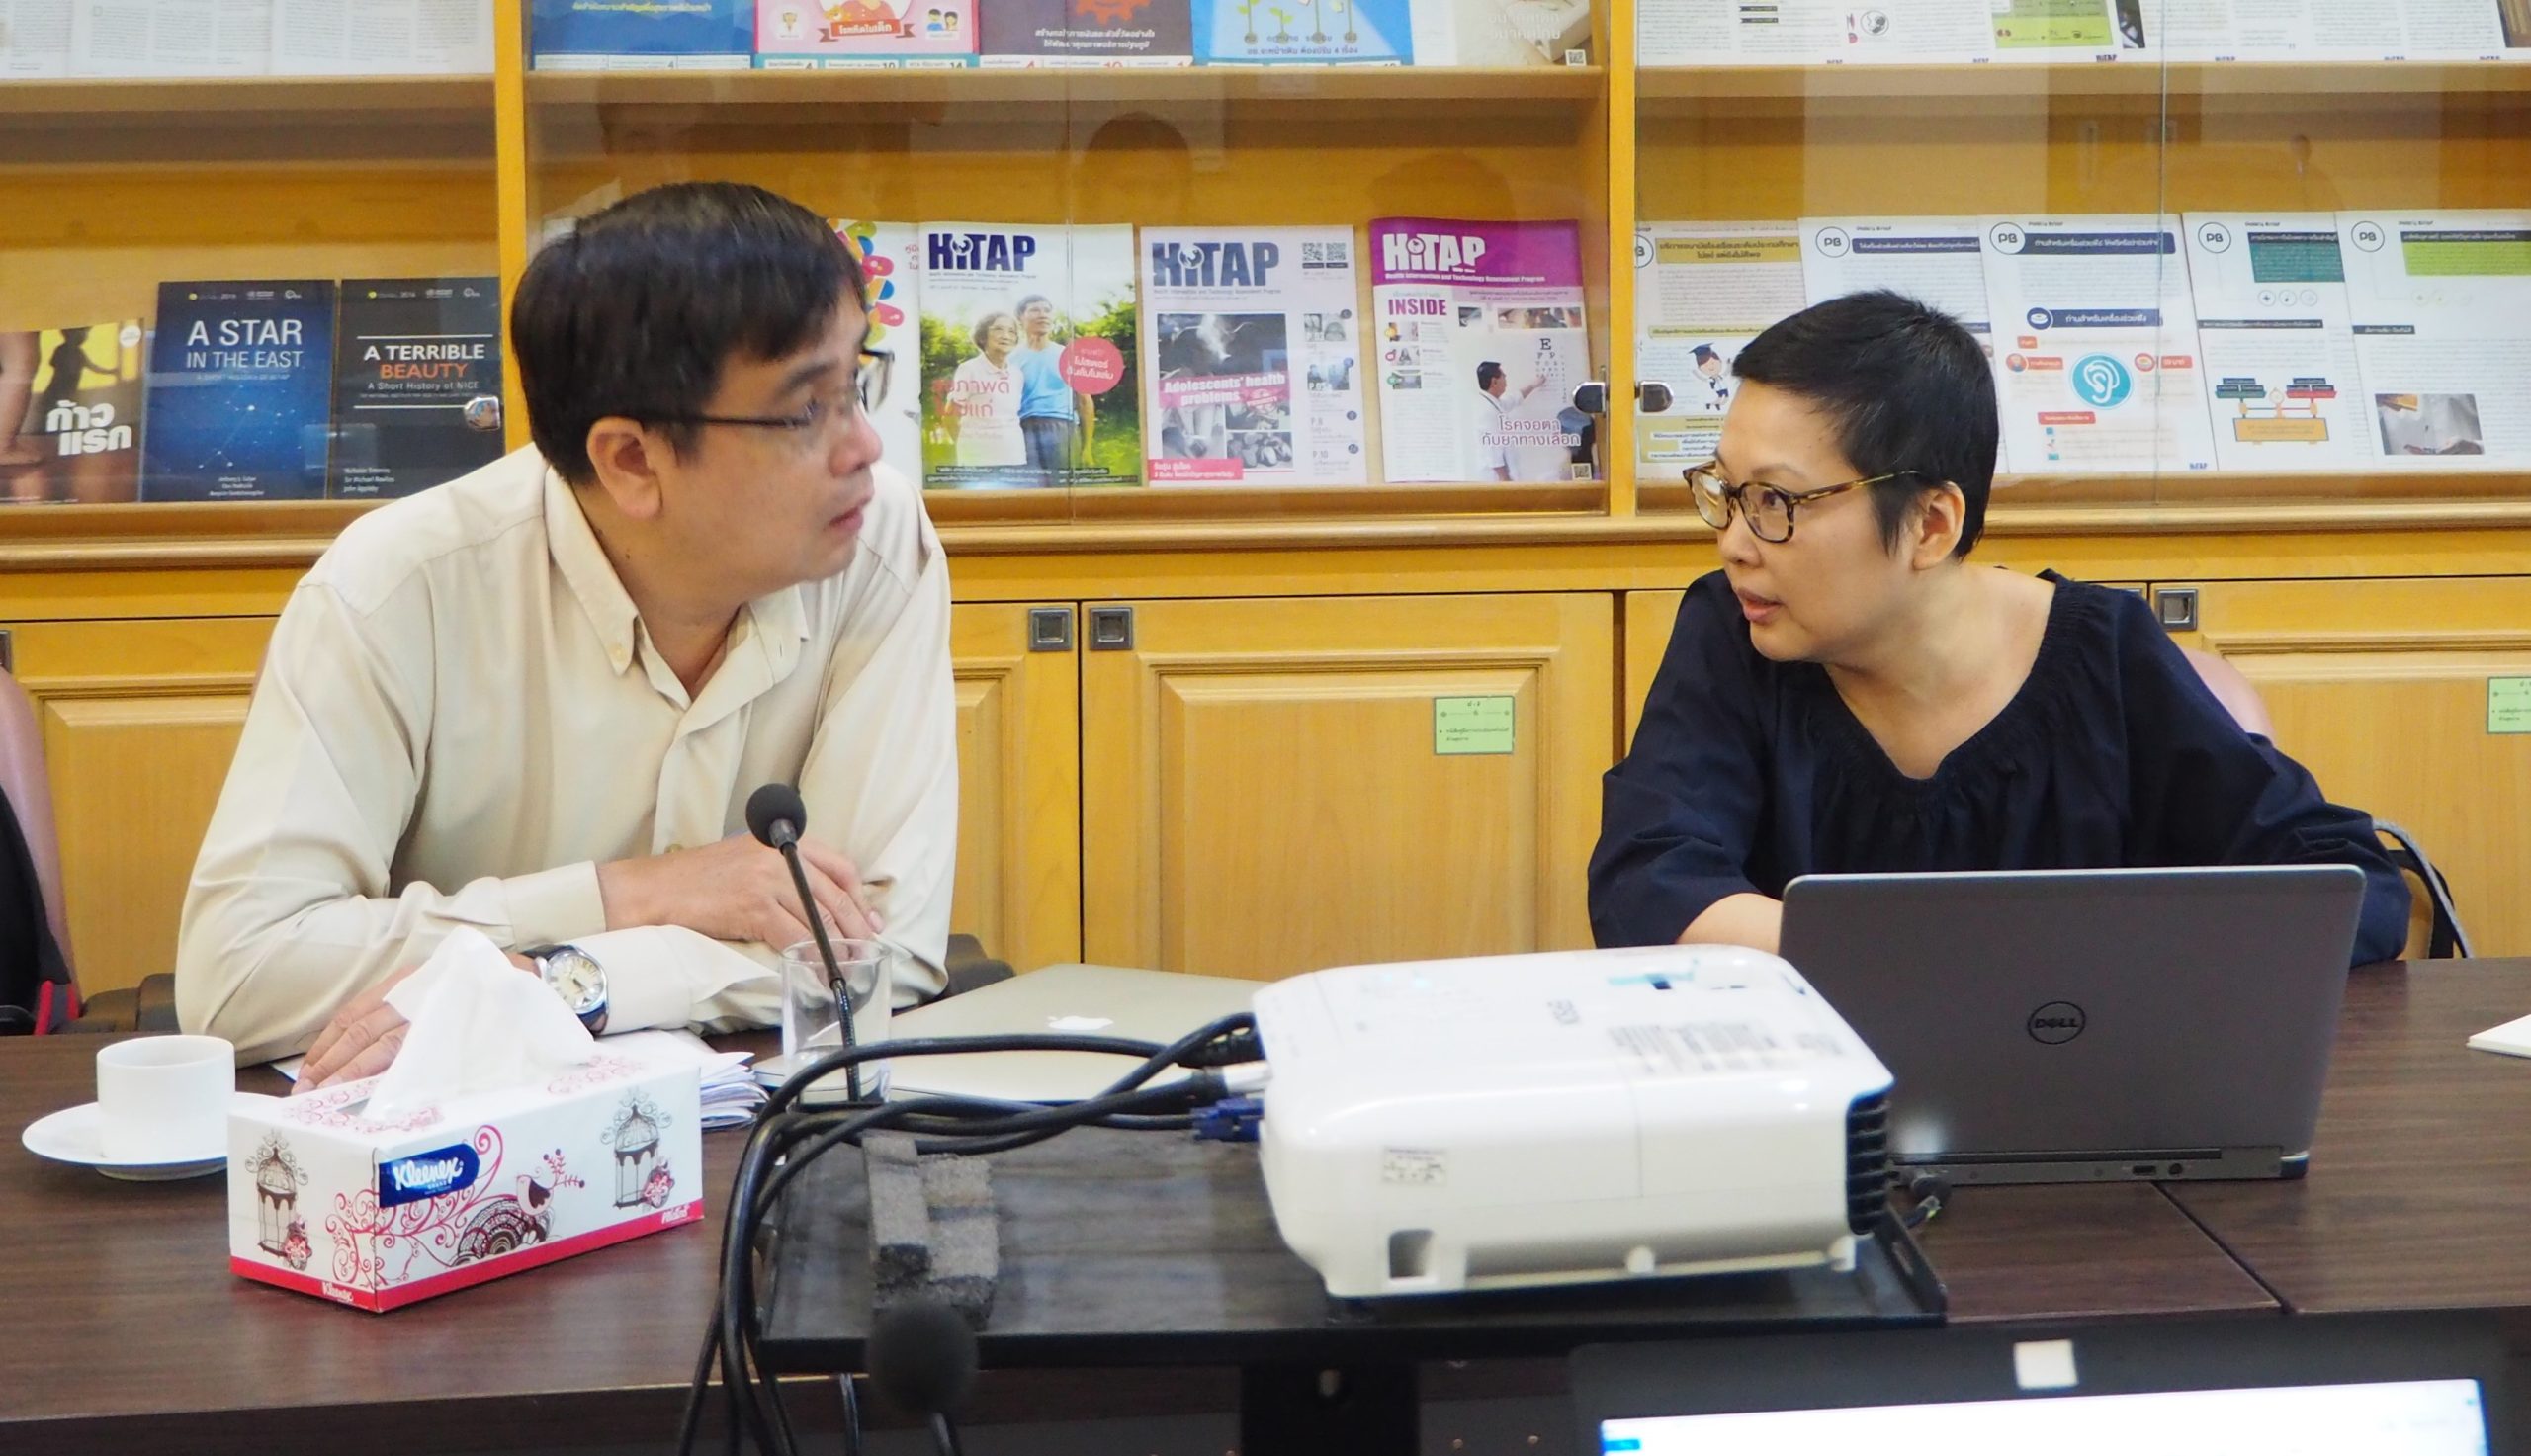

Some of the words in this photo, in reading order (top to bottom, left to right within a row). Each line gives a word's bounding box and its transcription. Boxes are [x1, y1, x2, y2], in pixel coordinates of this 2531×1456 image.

[1824, 237, 1842, 247] PB
[1998, 233, 2018, 243] PB
[2206, 233, 2224, 242] PB
[2359, 231, 2377, 241] PB
[1388, 299, 1447, 316] INSIDE
[187, 320, 210, 346] A
[219, 319, 303, 346] STAR
[1539, 337, 1551, 350] E
[187, 352, 206, 369] IN
[213, 351, 248, 368] THE
[254, 350, 304, 368] EAST
[364, 345, 381, 361] A
[385, 344, 485, 360] TERRIBLE
[380, 363, 469, 379] BEAUTY
[378, 382, 403, 390] Short
[406, 382, 441, 391] History
[444, 381, 453, 389] of
[456, 381, 480, 389] NICE
[1164, 376, 1244, 393] Adolescents'
[1245, 372, 1285, 387] health
[1179, 389, 1241, 407] problems
[45, 399, 115, 433] ก้าว
[1499, 415, 1560, 431] โรคจอตา
[58, 425, 132, 456] แรก
[1482, 432, 1581, 446] กับยาทางเลือก
[2034, 1017, 2078, 1028] DELL
[392, 1156, 464, 1191] Kleenex
